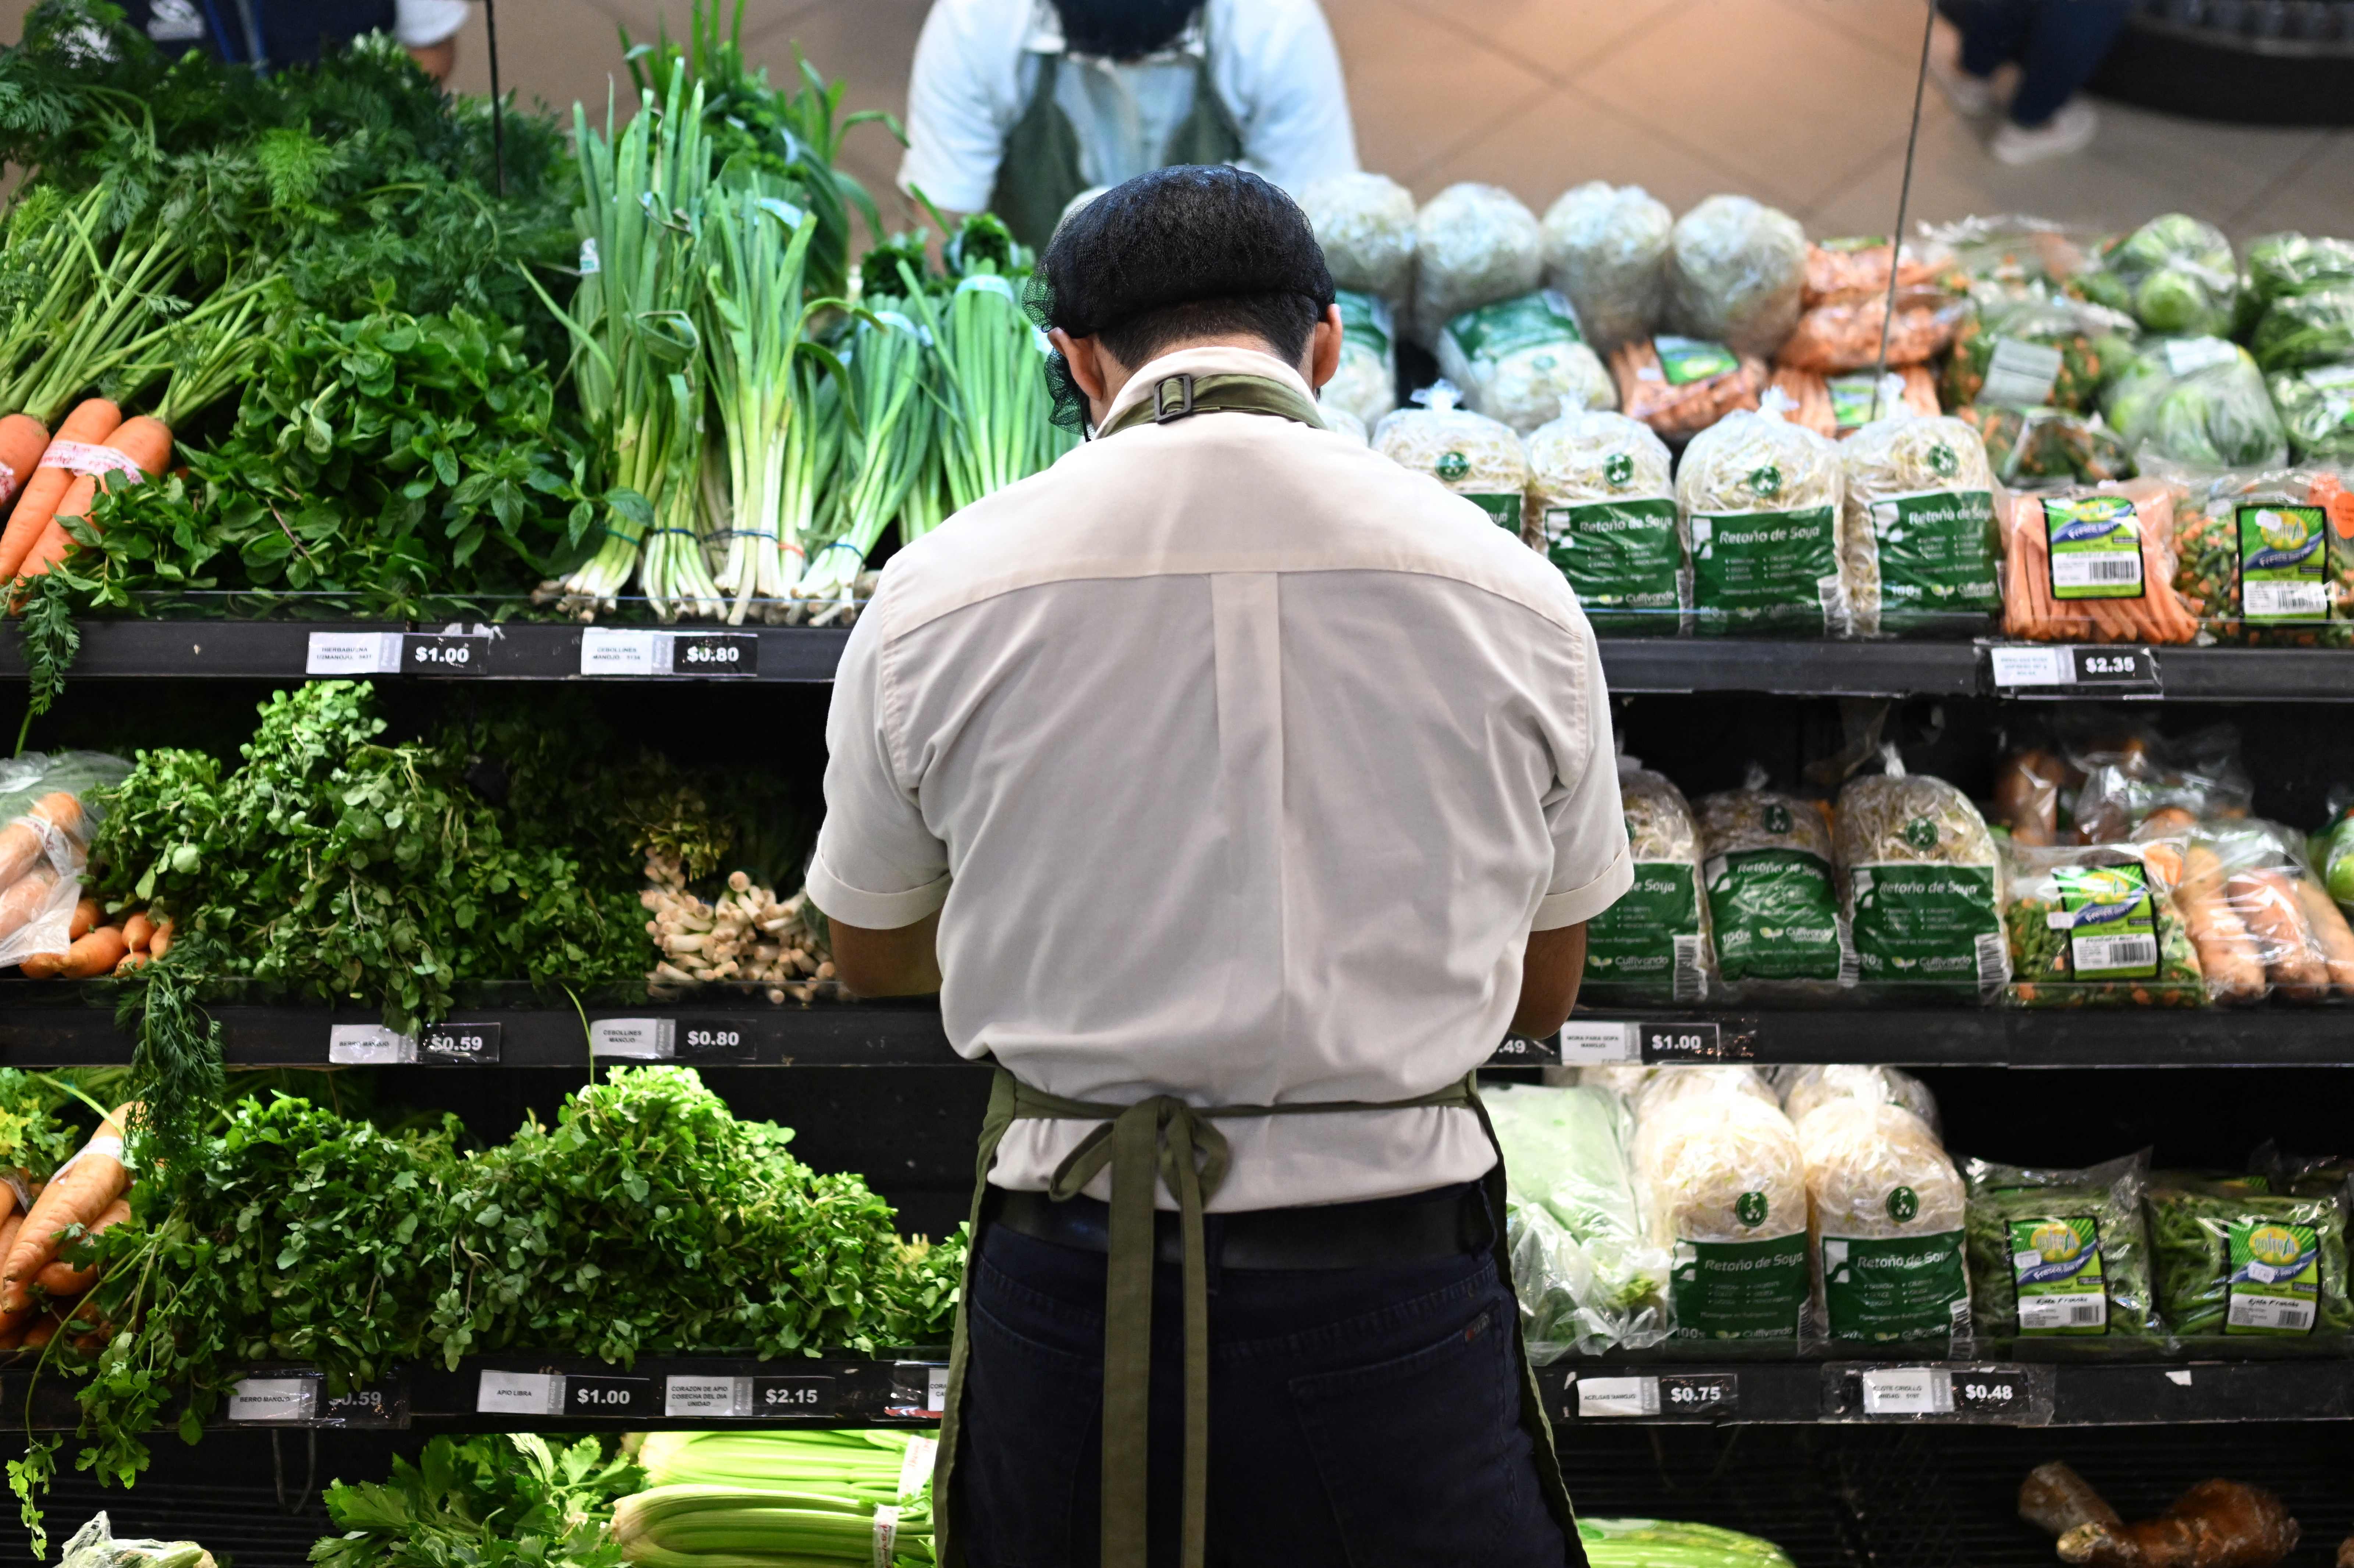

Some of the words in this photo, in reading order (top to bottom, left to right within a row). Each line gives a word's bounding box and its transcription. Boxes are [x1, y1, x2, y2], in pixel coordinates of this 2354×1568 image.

[1580, 517, 1625, 532] Retoño
[1628, 516, 1643, 530] de
[1719, 530, 1768, 545] Retoño
[1770, 528, 1787, 542] de
[1789, 525, 1820, 540] Soya
[415, 646, 470, 663] $1.00
[687, 646, 739, 663] $0.80
[2085, 656, 2135, 674] $2.35
[1630, 881, 1642, 892] e
[1644, 879, 1676, 895] Soya
[1879, 881, 1924, 894] Retoño
[1928, 882, 1944, 894] de
[1615, 955, 1669, 965] Cultivando
[430, 1036, 483, 1052] $0.59
[687, 1031, 739, 1046] $0.80
[1498, 1039, 1526, 1054] .49
[1652, 1034, 1702, 1050] $1.00
[1704, 1257, 1753, 1272] Retoño
[1755, 1256, 1771, 1269] de
[1774, 1252, 1804, 1267] Soya
[1857, 1254, 1903, 1268] Retoño
[1742, 1326, 1794, 1338] Cultivando
[577, 1389, 630, 1405] $1.00
[765, 1389, 818, 1405] $2.15
[1671, 1386, 1721, 1404] $0.75
[1966, 1384, 2013, 1400] $0.48
